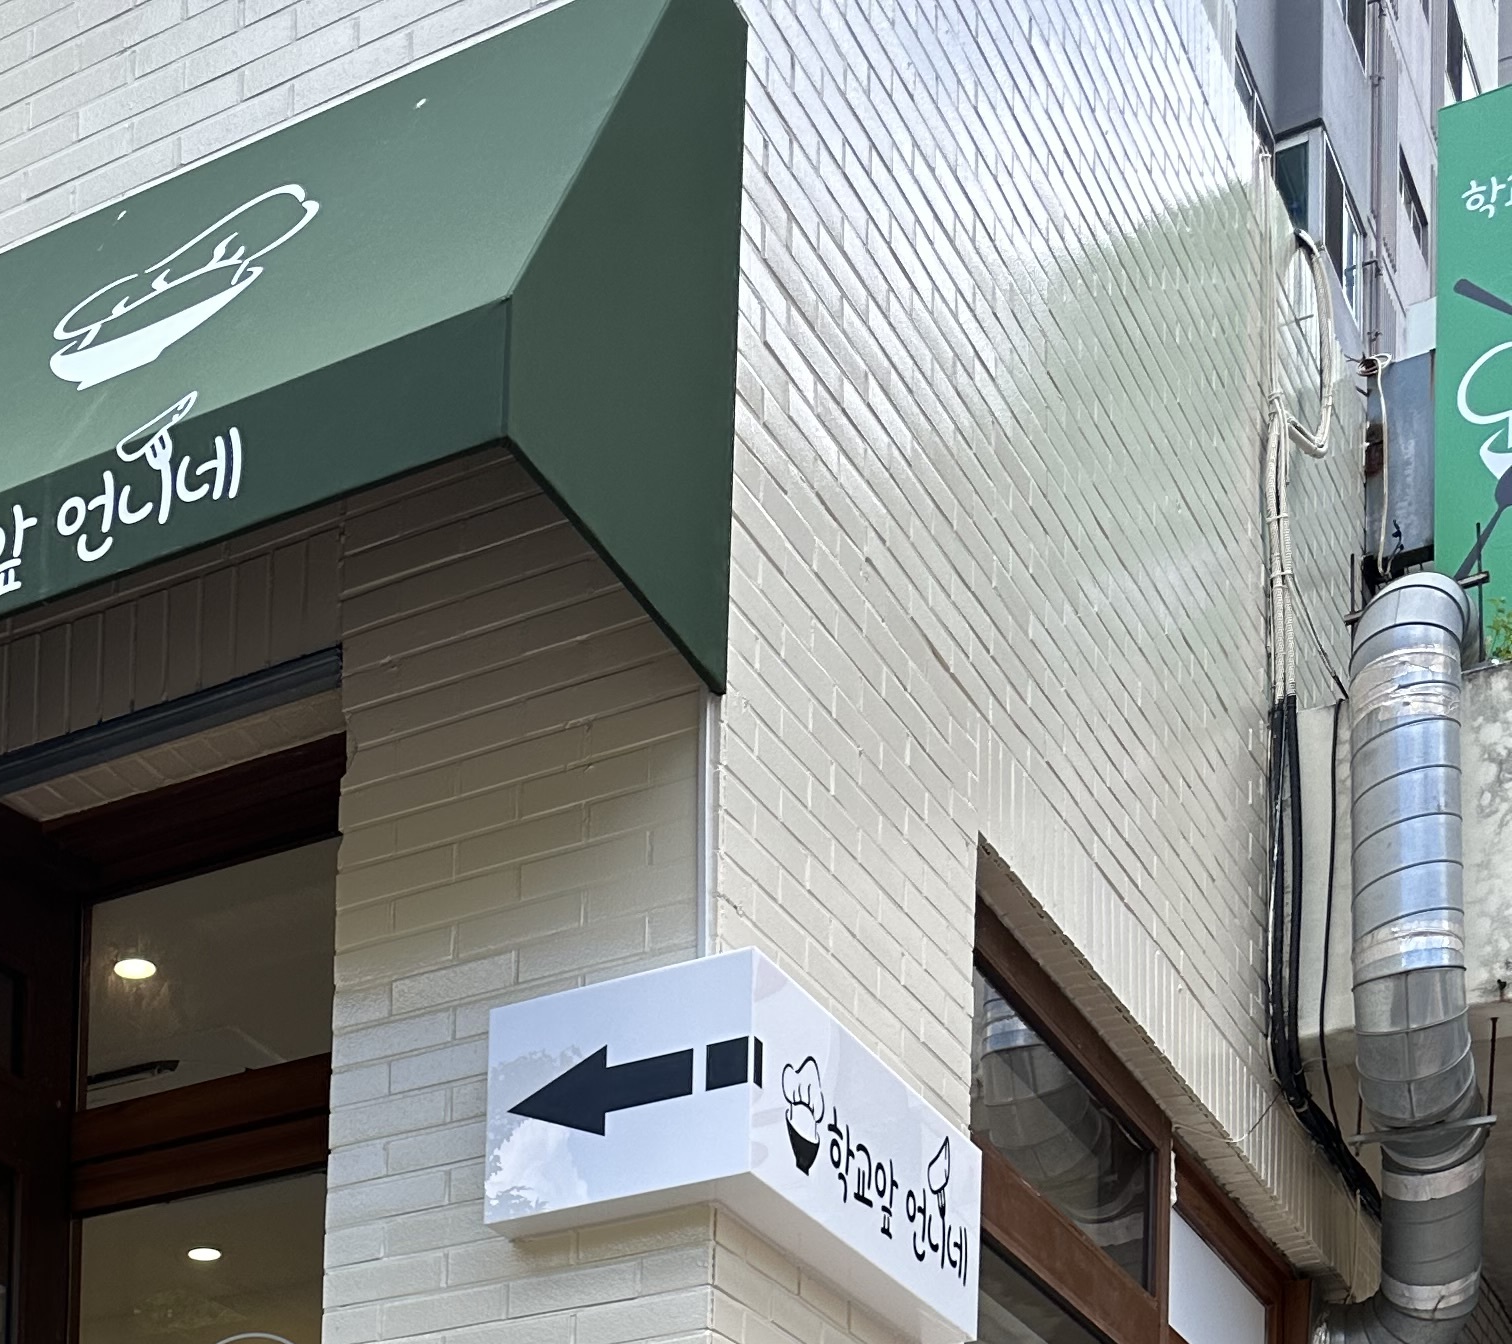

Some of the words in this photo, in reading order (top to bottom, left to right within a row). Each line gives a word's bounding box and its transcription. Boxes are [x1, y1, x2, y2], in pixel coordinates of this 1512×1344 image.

[1461, 175, 1512, 219] 학
[57, 427, 243, 562] 언니네
[828, 1107, 899, 1239] 학교앞
[905, 1187, 968, 1287] 언니네
